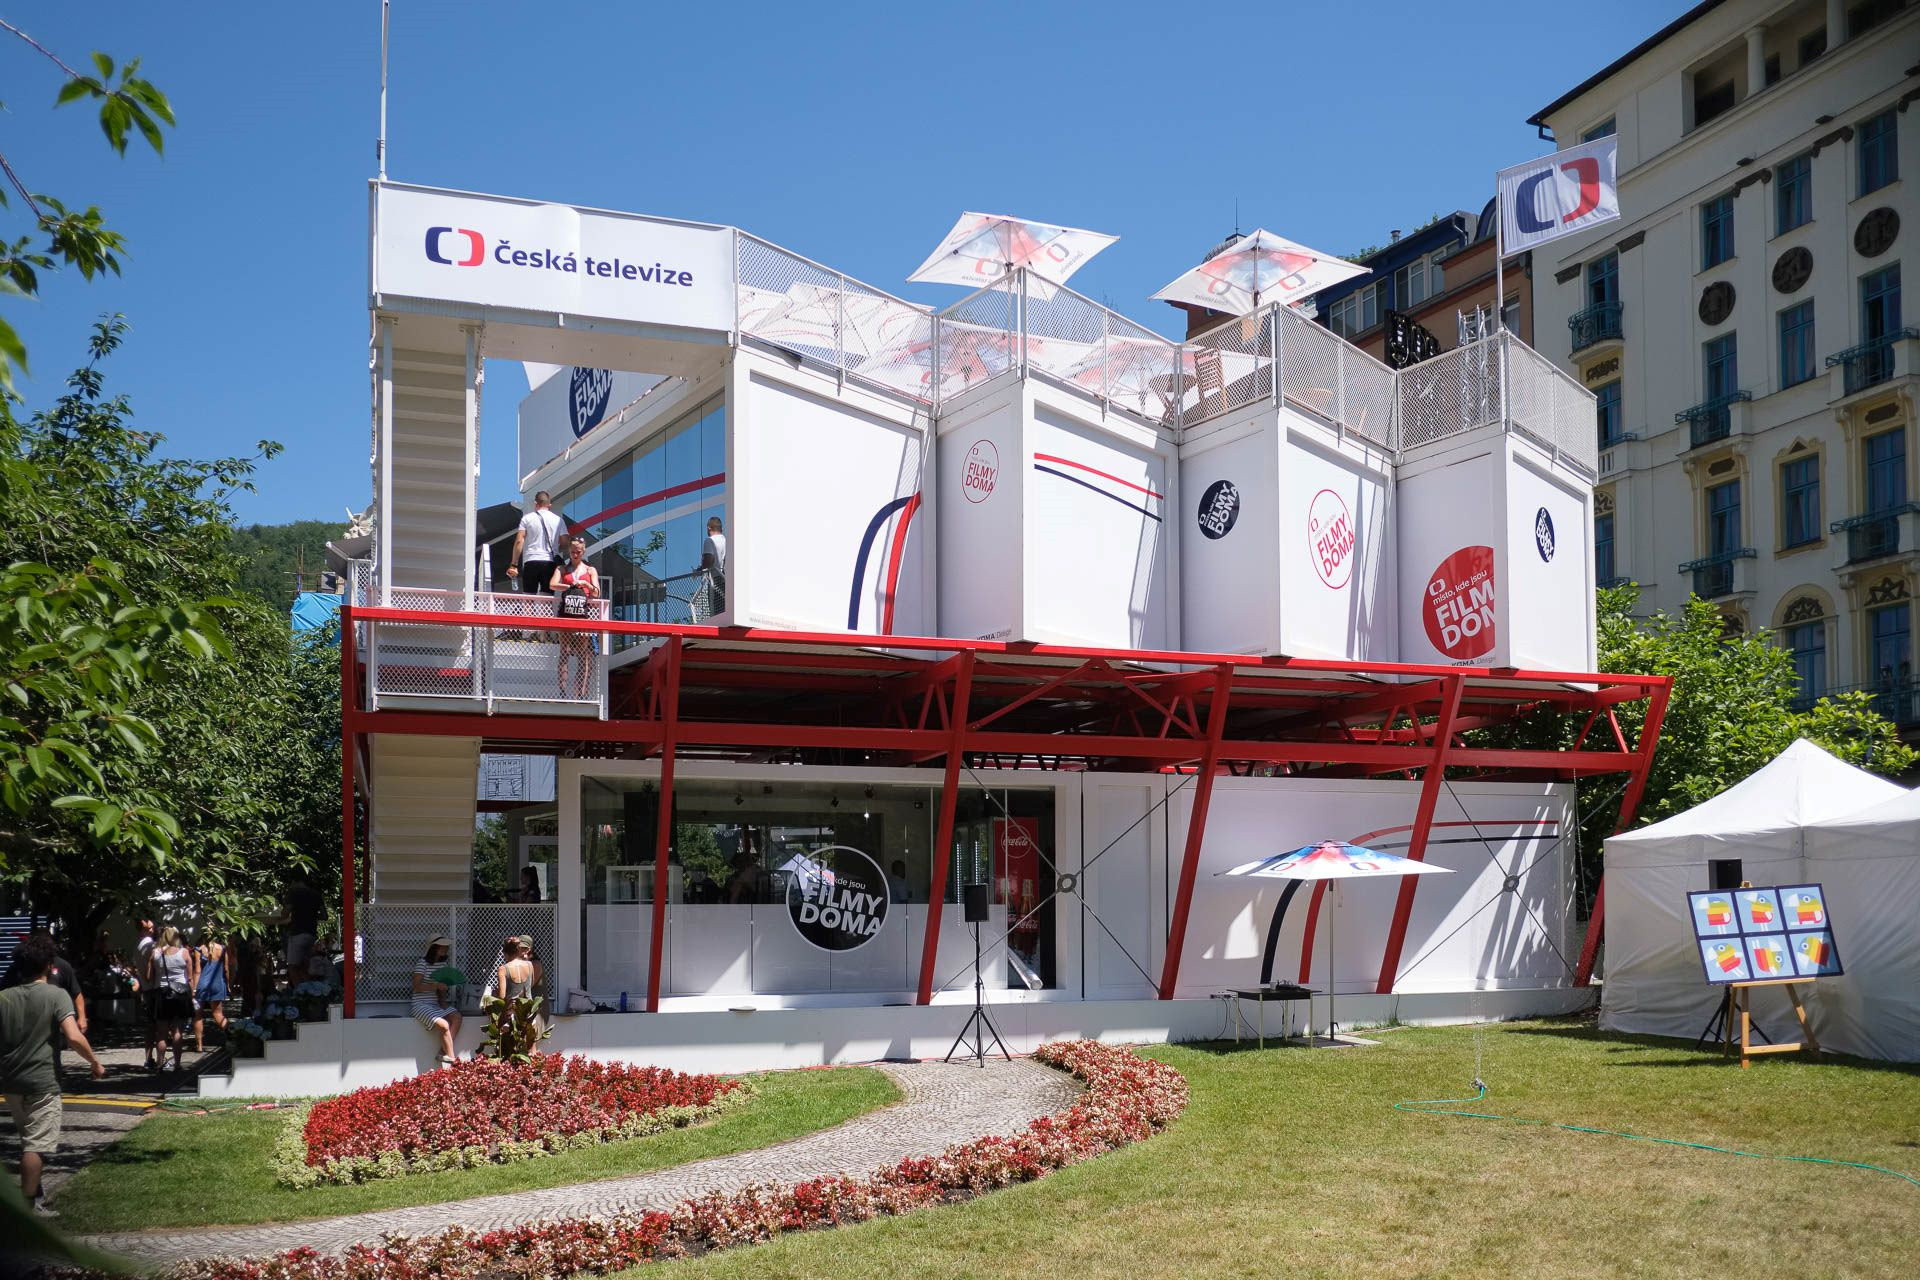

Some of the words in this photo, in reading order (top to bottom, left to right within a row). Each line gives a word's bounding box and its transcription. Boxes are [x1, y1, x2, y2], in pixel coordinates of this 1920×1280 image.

[494, 240, 577, 273] Česká
[585, 256, 693, 287] televize
[966, 474, 994, 493] DOMA
[968, 462, 996, 480] FILMY
[1206, 482, 1230, 531] FILMY
[1214, 486, 1238, 535] DOMA
[1317, 513, 1347, 560] FILMY
[1323, 530, 1355, 578] DOMA
[1455, 580, 1470, 592] kde
[1470, 570, 1488, 586] jsou
[1435, 579, 1495, 629] FILM
[803, 881, 884, 916] FILMY
[848, 879, 866, 890] jsou
[800, 902, 881, 936] DOMA
